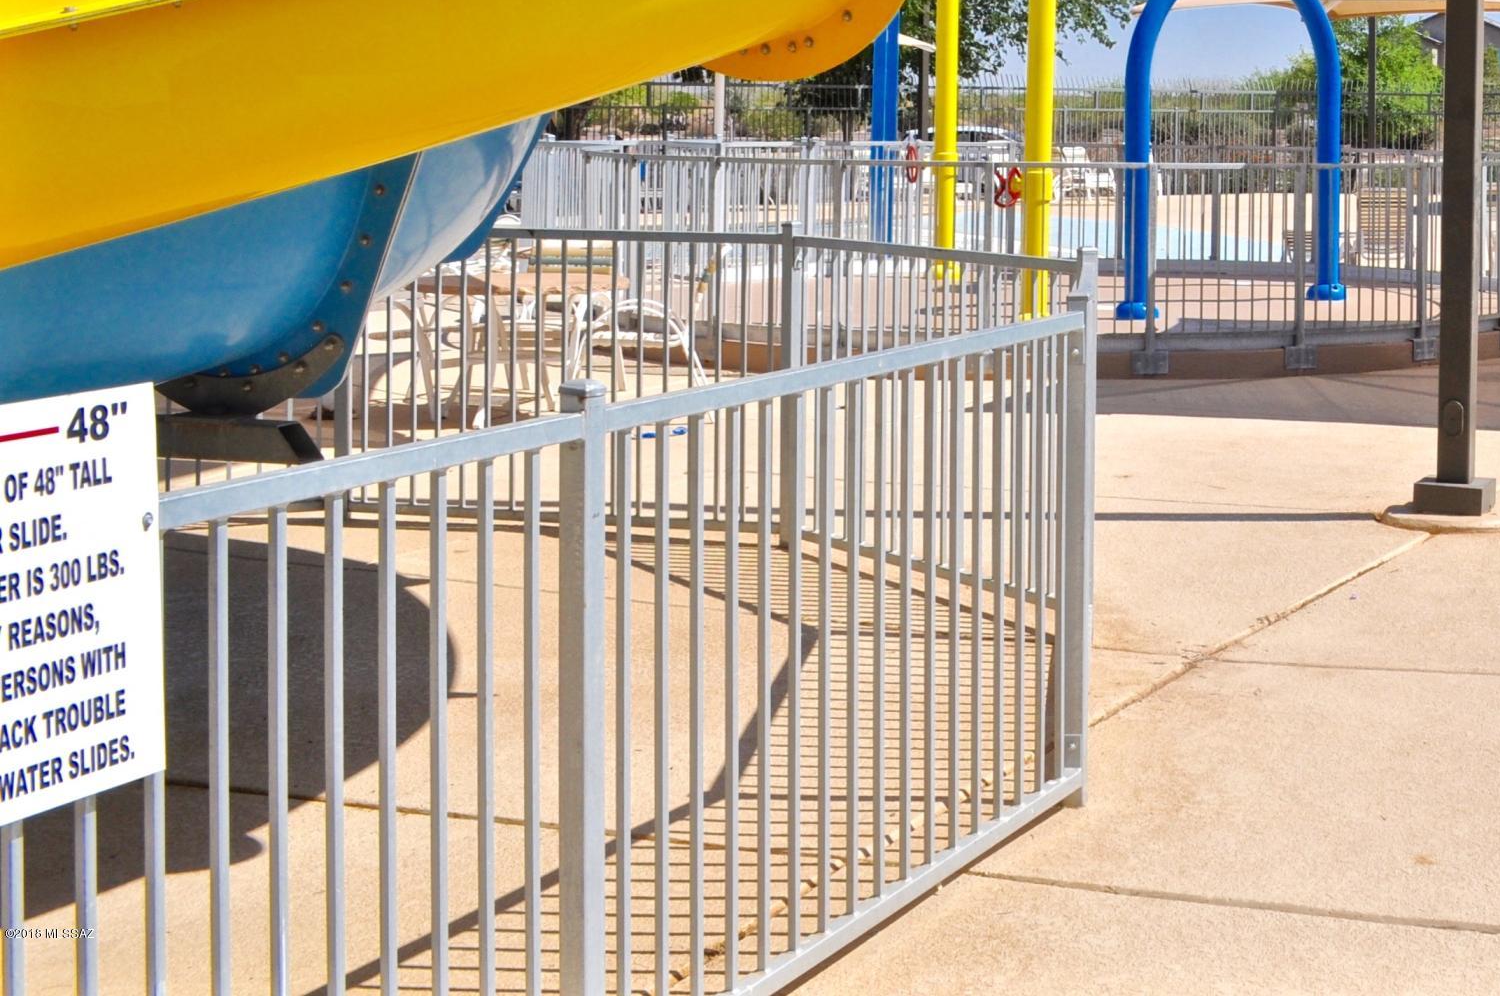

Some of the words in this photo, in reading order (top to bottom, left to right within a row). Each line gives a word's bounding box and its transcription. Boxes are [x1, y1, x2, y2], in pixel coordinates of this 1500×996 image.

[67, 401, 128, 444] 48"
[4, 471, 28, 503] OF
[34, 465, 64, 496] 48"
[69, 457, 113, 490] TALL
[9, 514, 67, 552] SLIDE.
[27, 567, 44, 597] IS
[50, 558, 81, 592] 300
[87, 549, 125, 583] LBS.
[8, 603, 100, 652] REASONS,
[81, 642, 126, 680] WITH
[42, 689, 126, 739] TROUBLE
[0, 756, 63, 802] WATER
[69, 735, 135, 780] SLIDES.
